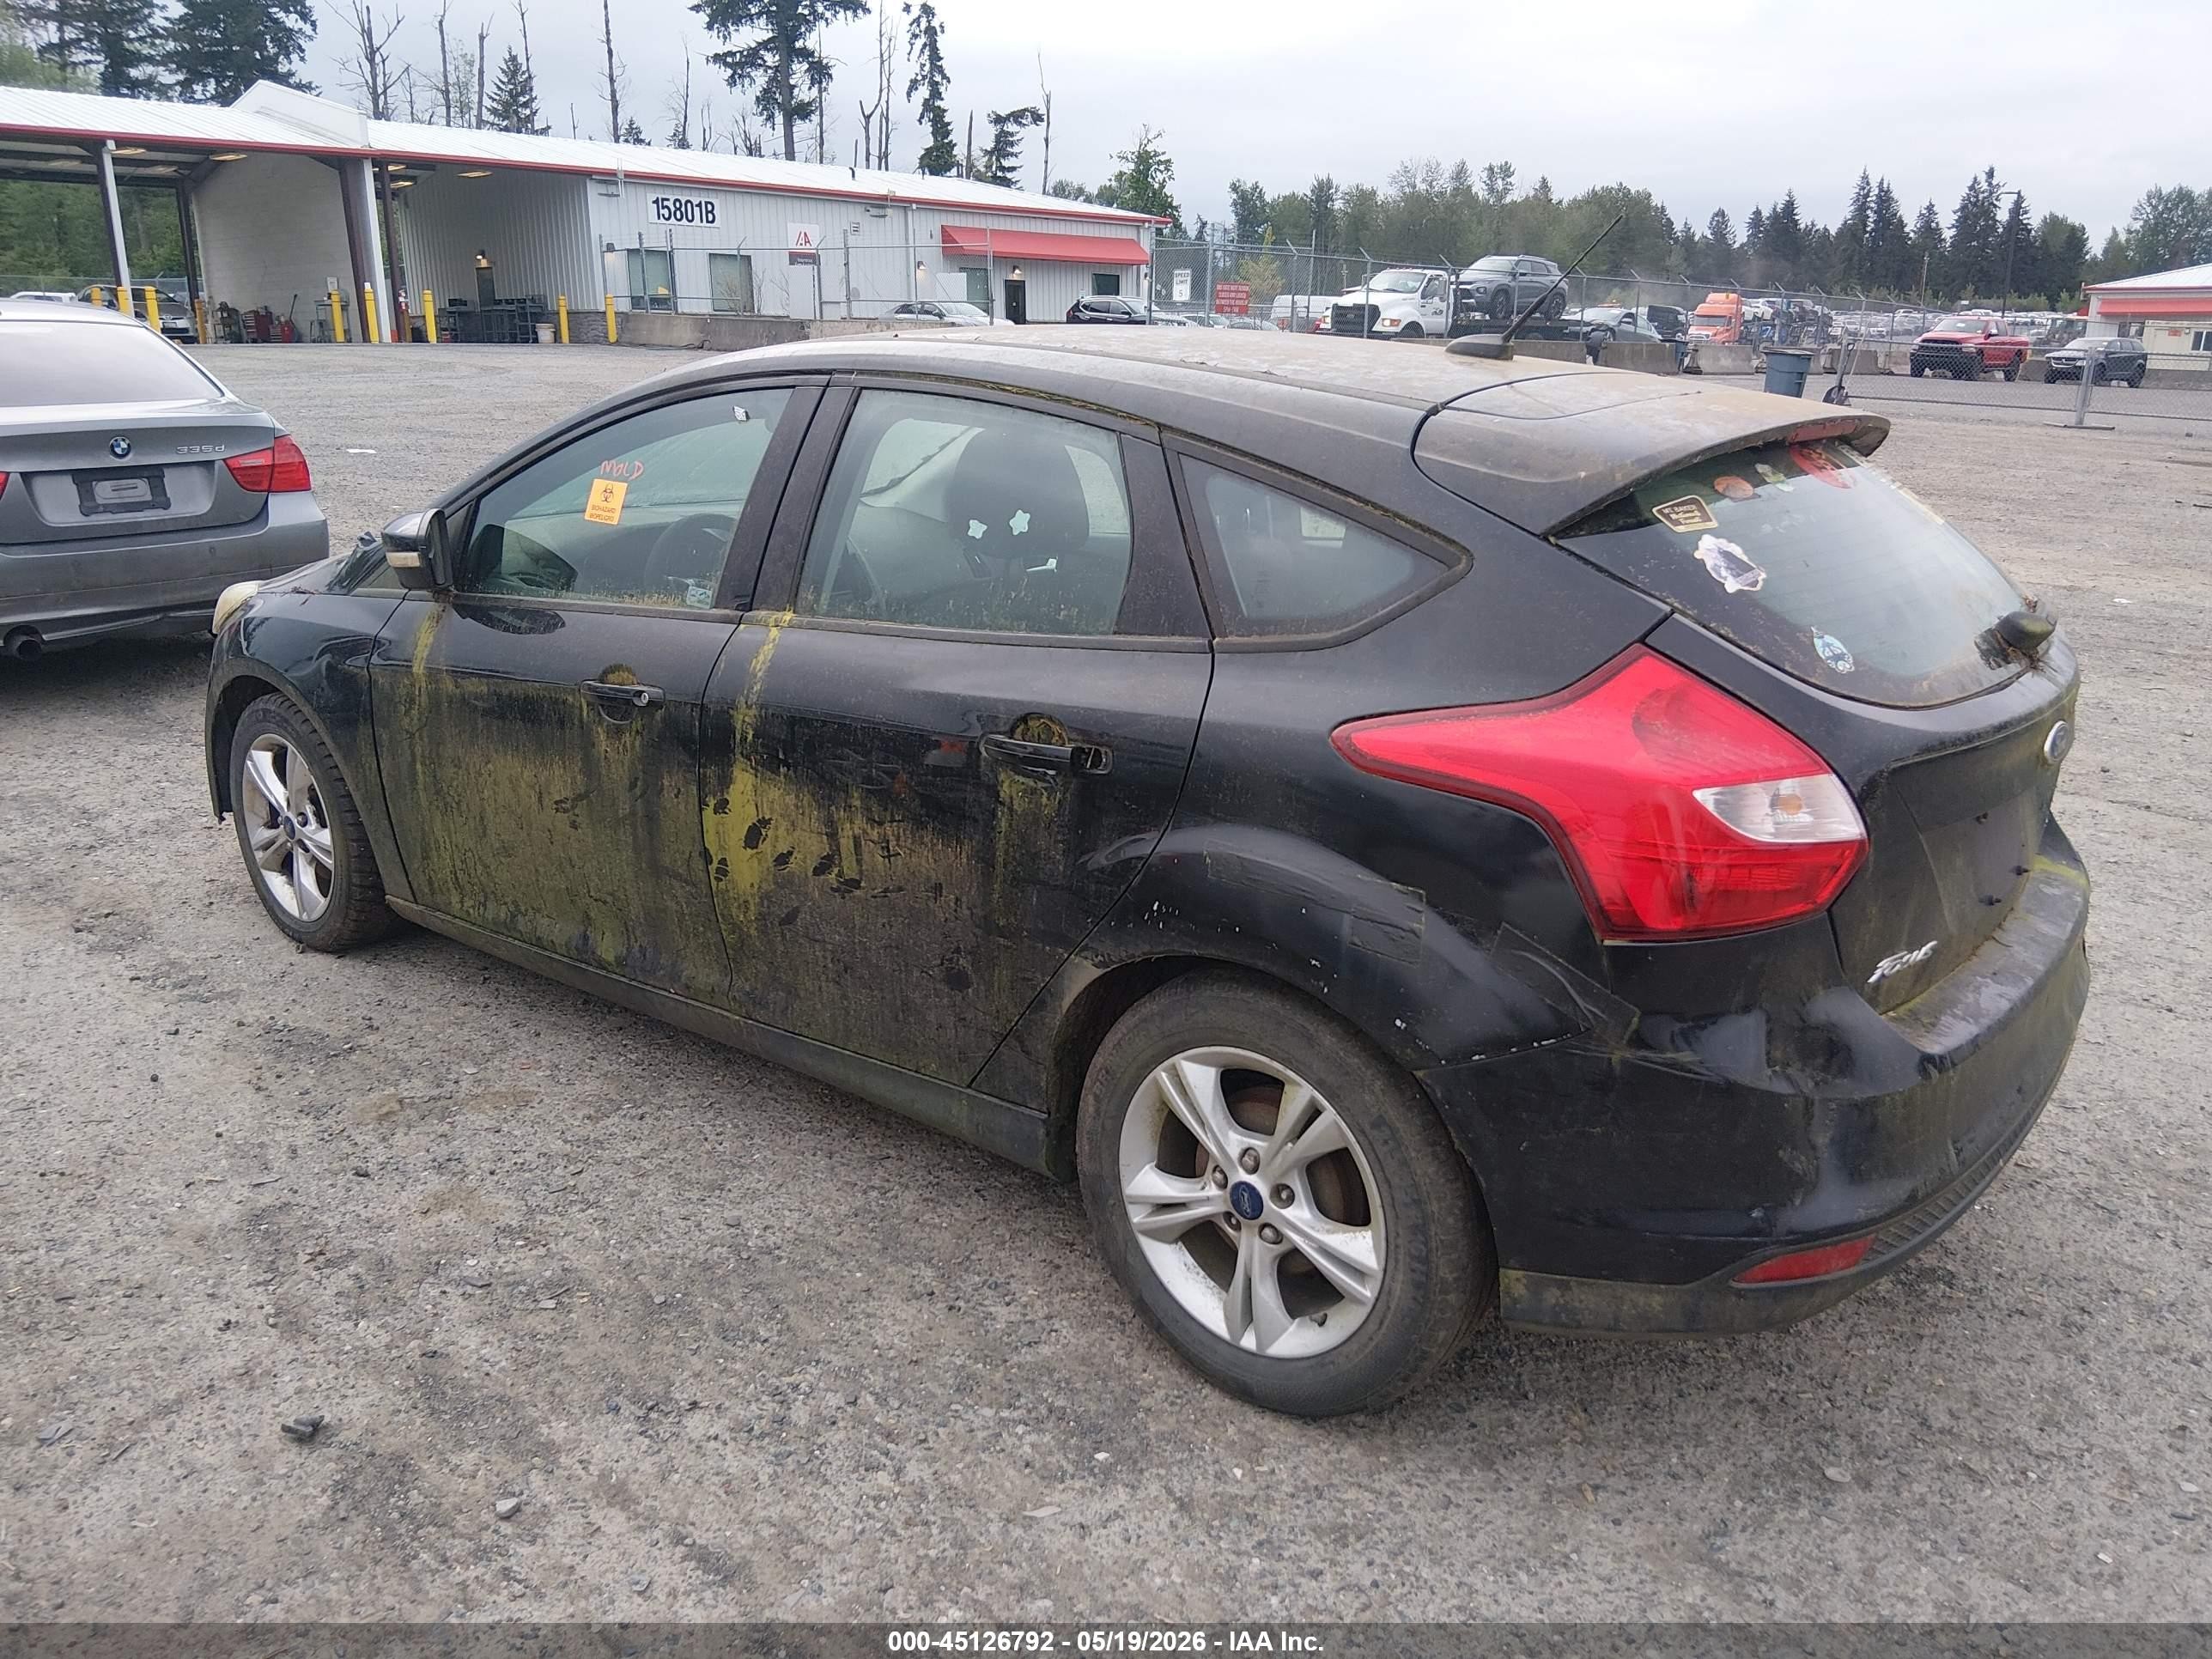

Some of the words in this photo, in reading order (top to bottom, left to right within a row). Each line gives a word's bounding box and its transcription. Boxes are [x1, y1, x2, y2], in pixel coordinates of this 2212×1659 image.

[652, 197, 716, 224] 15801B
[177, 445, 225, 454] 335d
[600, 459, 644, 481] MOLD
[591, 504, 617, 514] BIOHAZARD
